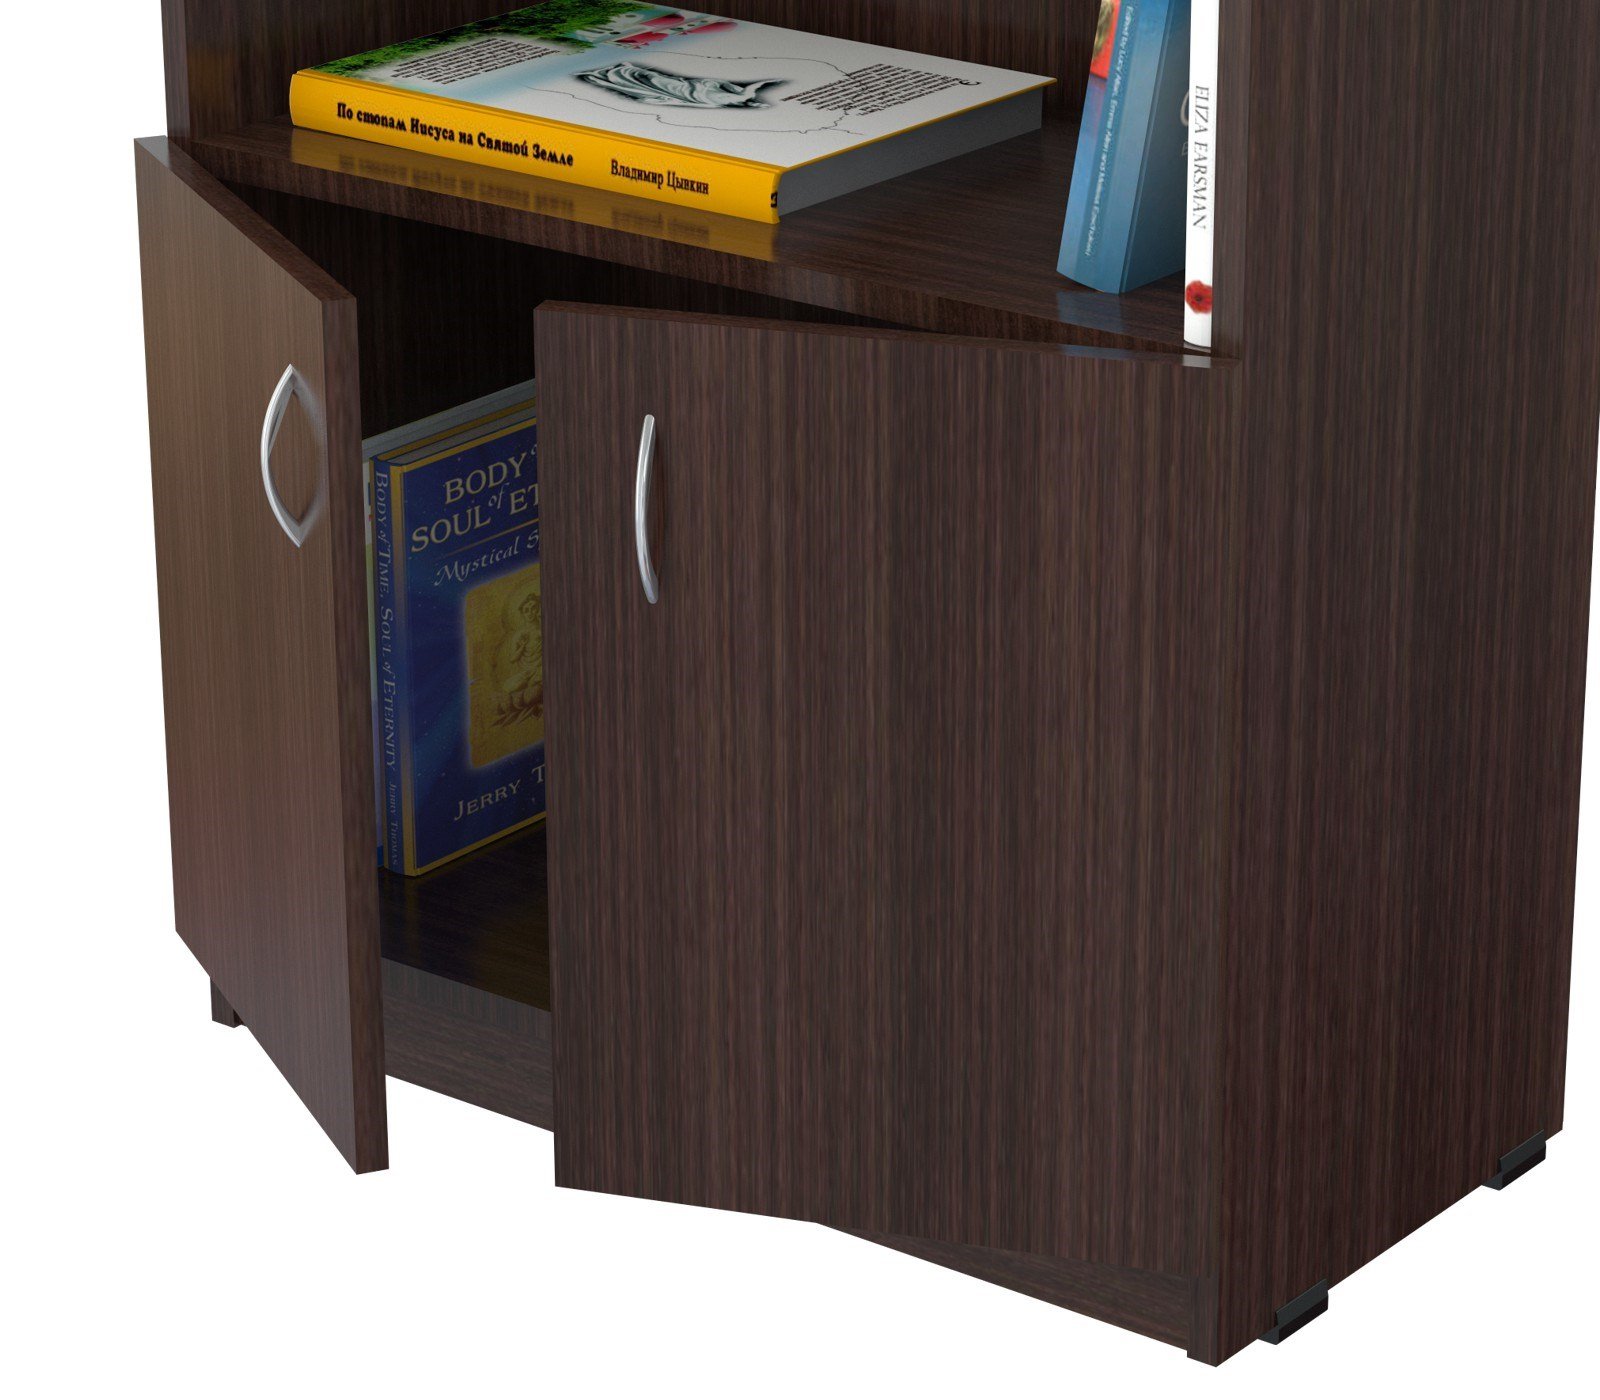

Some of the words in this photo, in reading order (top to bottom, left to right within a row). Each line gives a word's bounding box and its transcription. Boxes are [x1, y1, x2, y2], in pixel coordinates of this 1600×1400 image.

[337, 102, 353, 120] По
[356, 110, 407, 132] стопам
[458, 130, 474, 146] на
[477, 131, 529, 157] Святой
[532, 143, 574, 167] Земле
[1194, 85, 1210, 133] ELIZA
[611, 159, 664, 189] Владимир
[667, 170, 709, 195] Цывкин
[1193, 141, 1208, 230] EARSMAN
[376, 471, 388, 527] BODY
[443, 452, 527, 505] BODY
[411, 505, 492, 552] SOUL
[488, 482, 510, 509] of
[433, 535, 520, 586] Mystical
[380, 606, 394, 657] SOUL
[383, 680, 396, 771] ETERNITY
[454, 779, 521, 821] JERRY
